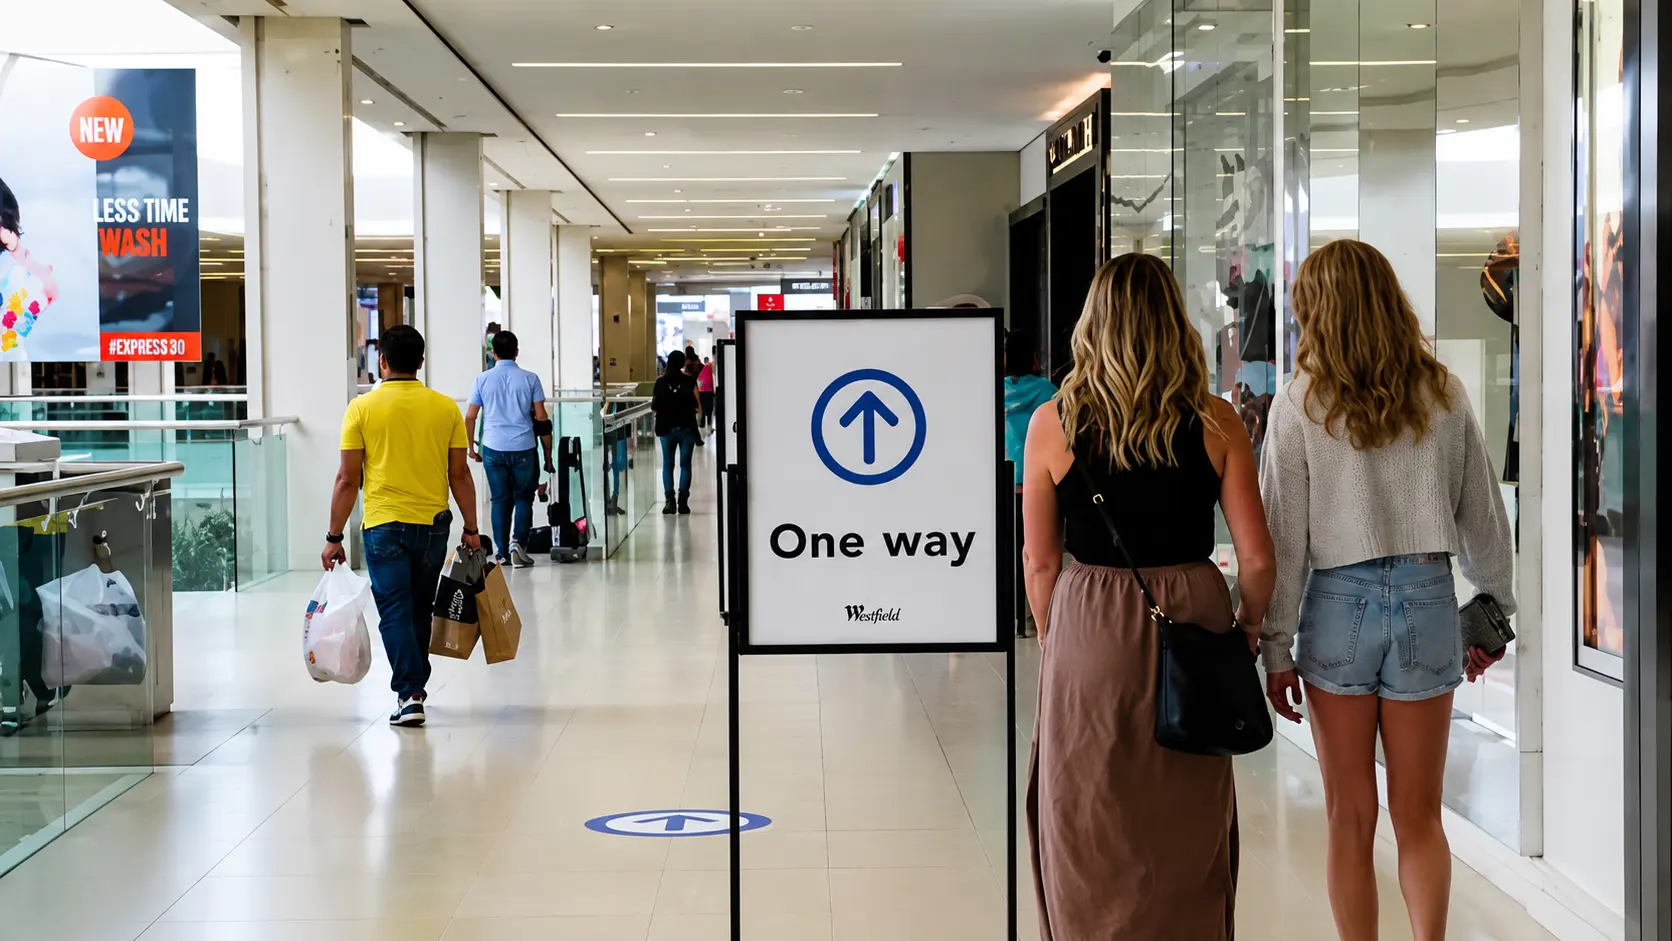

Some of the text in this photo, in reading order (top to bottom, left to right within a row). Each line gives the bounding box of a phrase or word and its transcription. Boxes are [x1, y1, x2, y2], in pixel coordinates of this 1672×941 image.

[79, 117, 125, 143] NEW
[93, 198, 189, 223] LESS TIME
[98, 227, 167, 257] WASH
[109, 339, 185, 355] #EXPRESS 30
[770, 523, 976, 567] One way
[844, 604, 901, 624] Westfield
